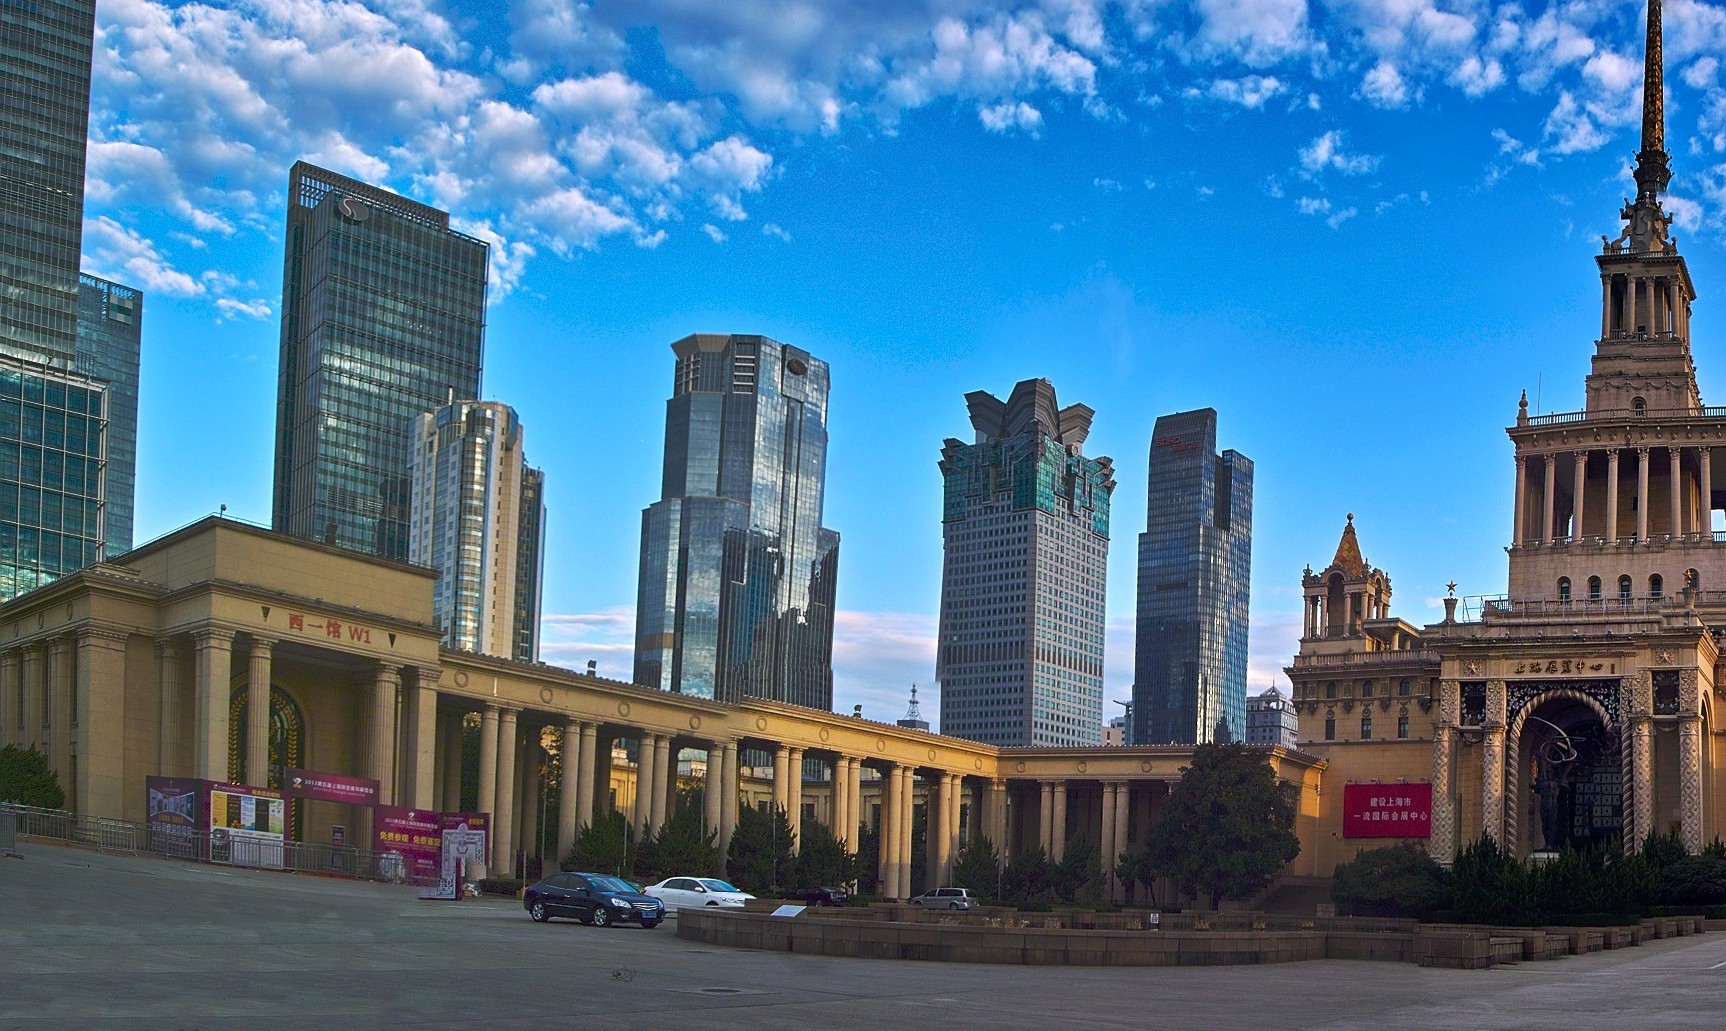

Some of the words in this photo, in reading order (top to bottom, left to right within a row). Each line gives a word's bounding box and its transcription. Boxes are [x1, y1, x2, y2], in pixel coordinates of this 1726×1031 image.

[288, 613, 342, 639] 西一馆
[348, 625, 371, 644] W1
[1370, 797, 1411, 807] 建设上海市
[1353, 811, 1428, 821] 一流国际会展中心
[380, 831, 409, 843] 免费参观
